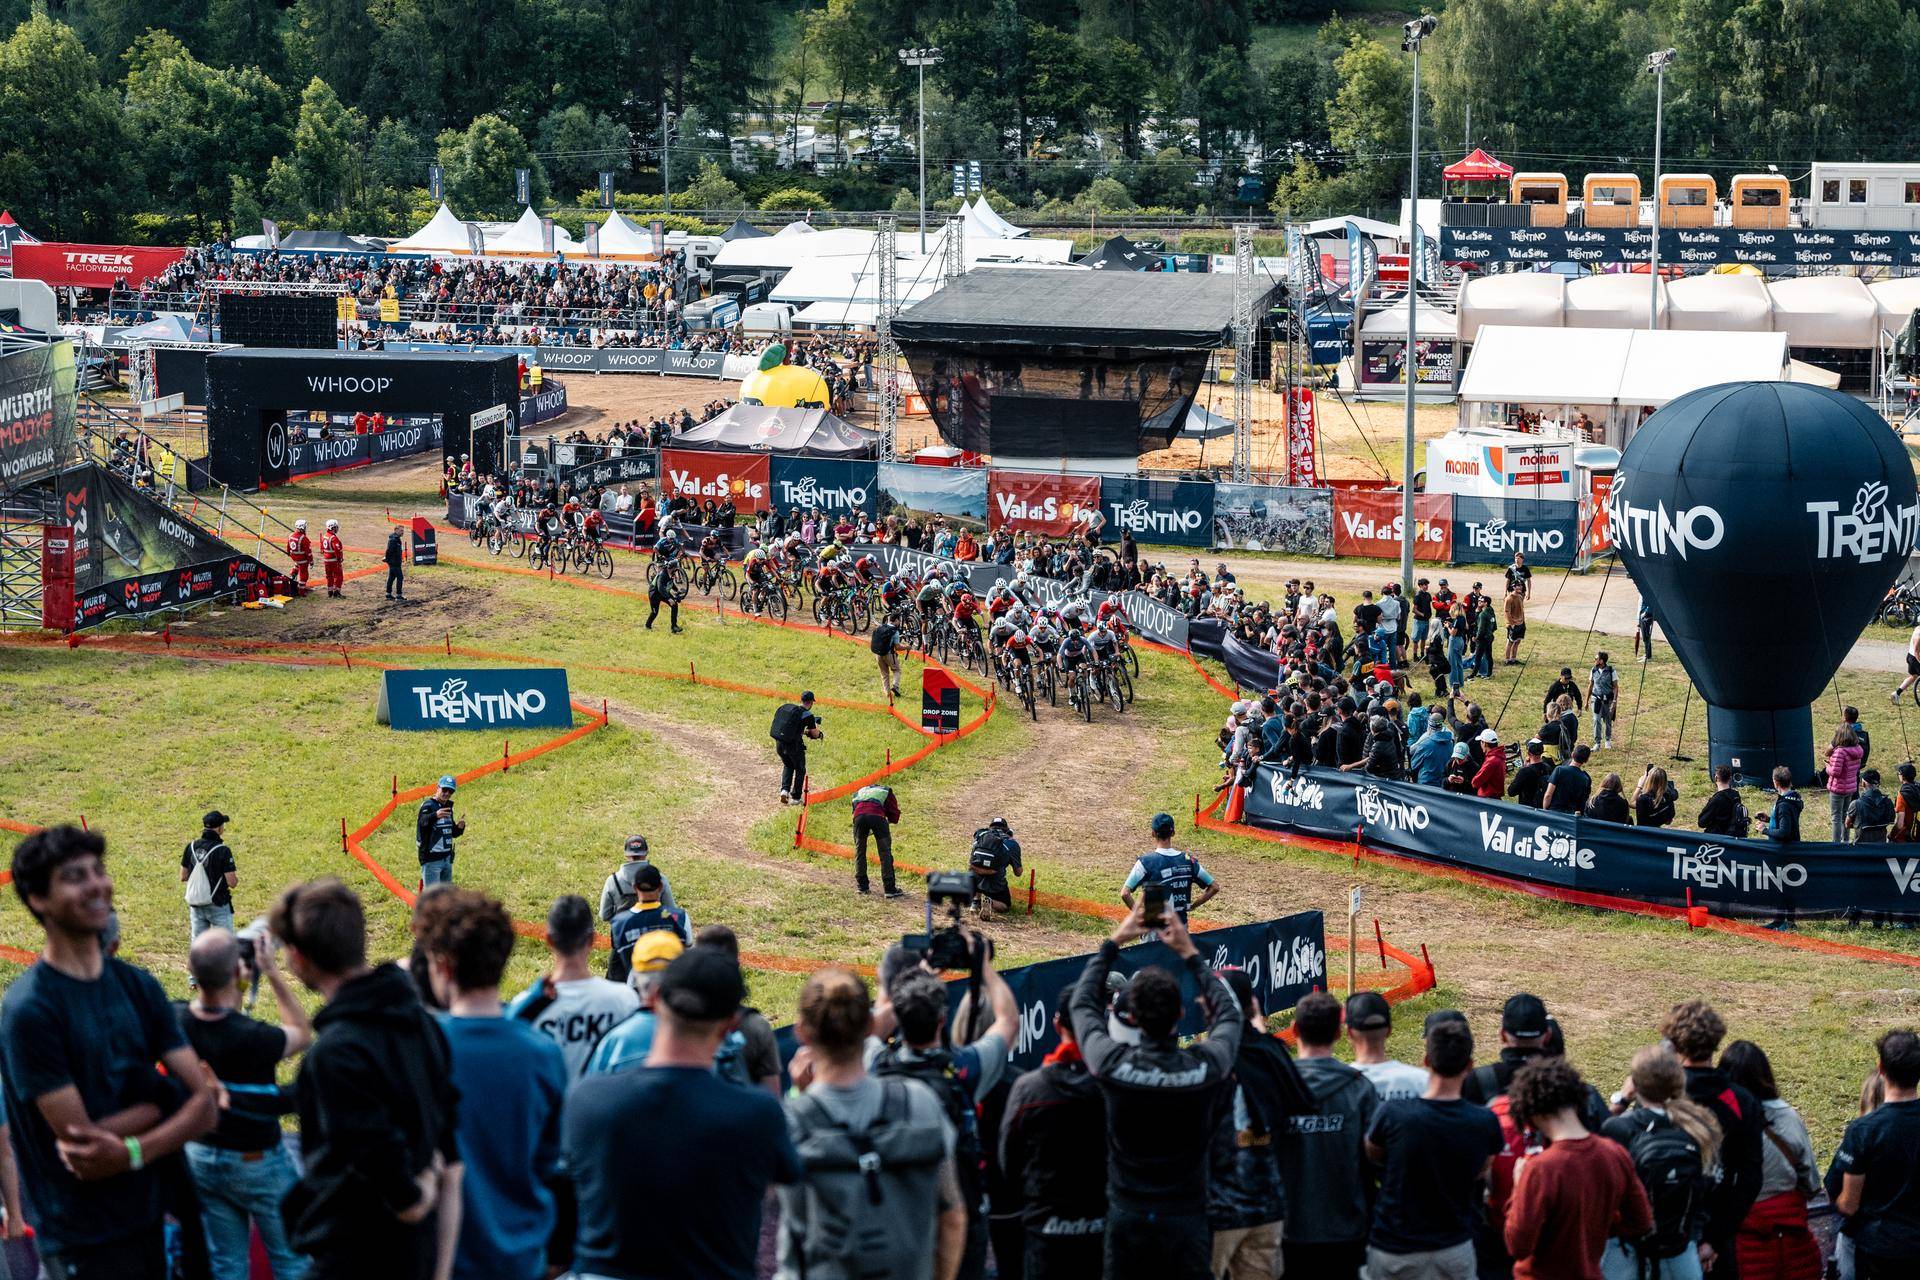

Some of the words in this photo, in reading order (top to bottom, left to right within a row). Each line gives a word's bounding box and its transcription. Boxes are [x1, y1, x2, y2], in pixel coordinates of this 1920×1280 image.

[1510, 230, 1546, 241] TRENTINO
[1624, 231, 1660, 242] TRENTIN
[1738, 232, 1775, 244] TRENTINO
[1853, 233, 1890, 245] TRENTINO
[62, 252, 135, 265] TREK
[1454, 247, 1489, 259] TRENTINO
[1567, 248, 1602, 260] TRENTINO
[1680, 249, 1716, 262] TRENTINO
[1795, 250, 1831, 263] TRENTINO
[544, 354, 591, 364] WHOOP
[608, 355, 656, 365] WHOOP
[672, 357, 716, 368] WHOOP
[307, 376, 390, 393] WHOOP
[0, 387, 52, 422] WÜRTH
[536, 390, 563, 412] WHOOP
[0, 412, 53, 448] MODYF
[379, 428, 421, 452] WHOOP
[314, 438, 357, 462] WHOOP
[2, 448, 54, 478] WORKWEAR
[669, 470, 699, 495] Val
[702, 482, 715, 496] di
[716, 474, 762, 498] Sole
[780, 481, 867, 509] TRENTINO
[996, 492, 1026, 519] Val
[1029, 506, 1043, 520] di
[1110, 503, 1202, 534] TRENTINO
[1341, 511, 1374, 539] Val
[1377, 526, 1391, 540] di
[1465, 522, 1564, 553] TRENTINO
[1121, 594, 1175, 637] WHOOP
[412, 687, 546, 723] TRENTINO
[1355, 786, 1429, 834] TRENTINO
[1479, 811, 1512, 854] Val
[1515, 837, 1532, 857] di
[1534, 825, 1595, 870] Sole
[1667, 846, 1808, 893] TRENTINO
